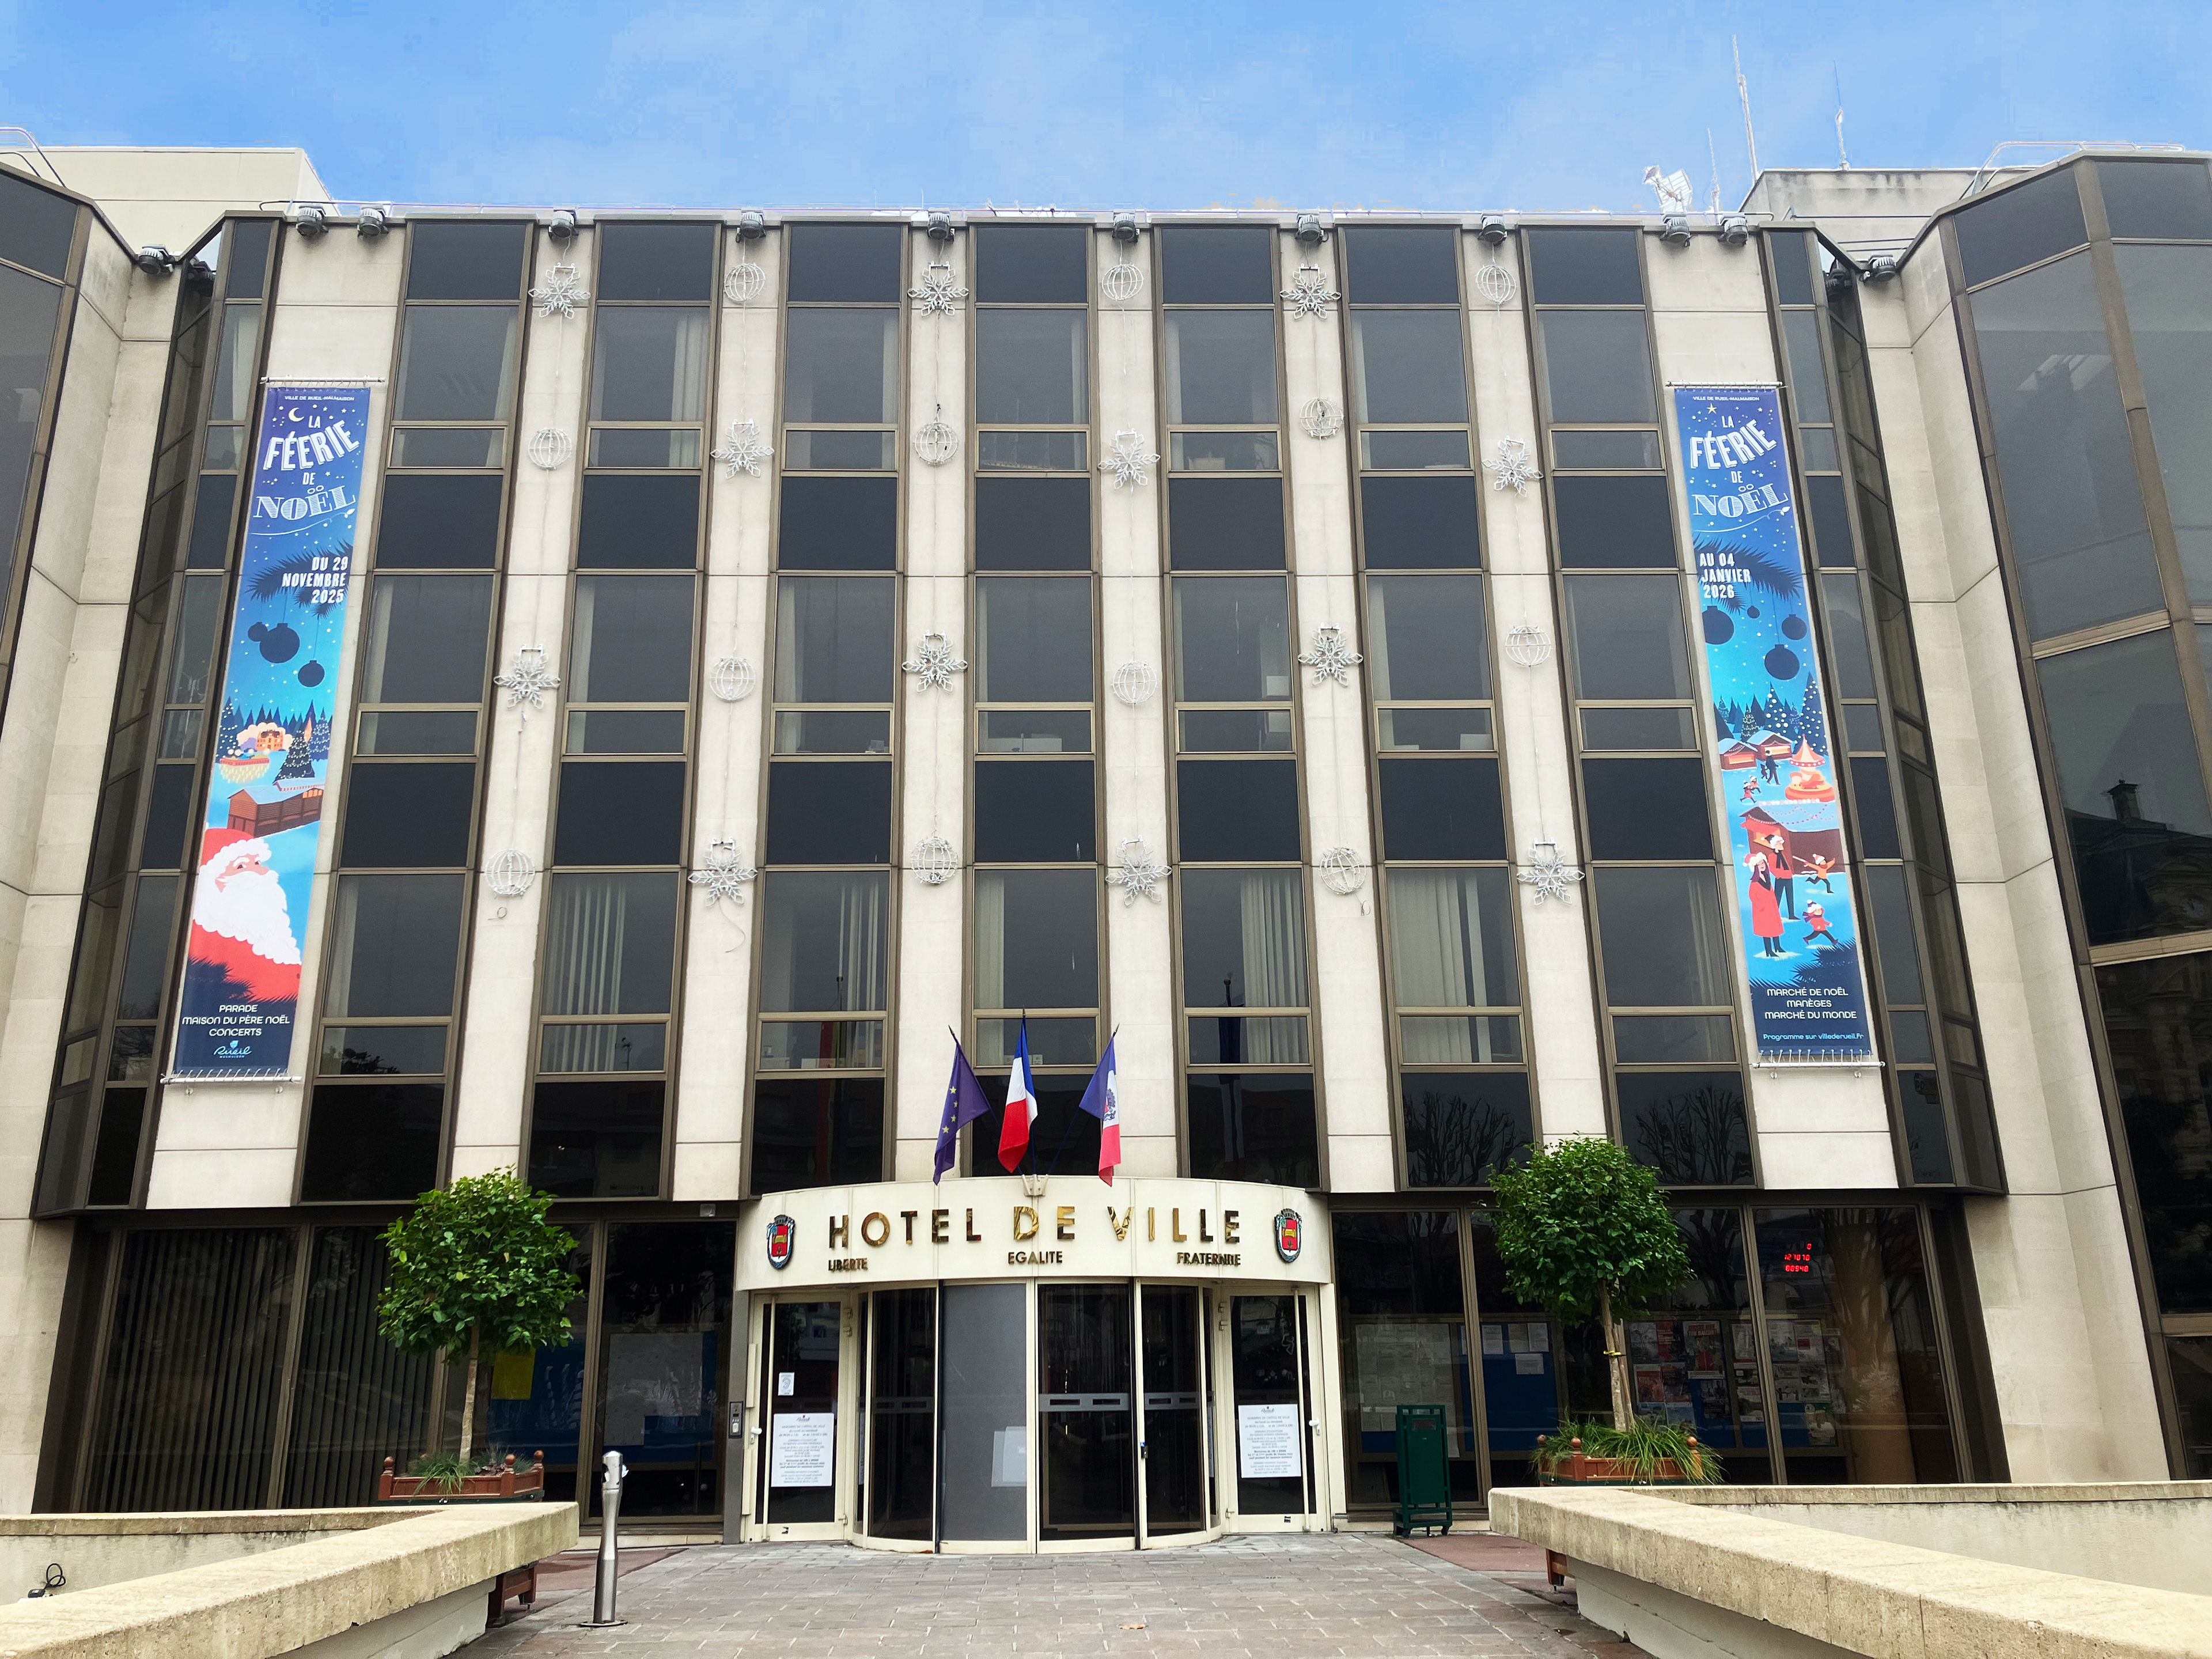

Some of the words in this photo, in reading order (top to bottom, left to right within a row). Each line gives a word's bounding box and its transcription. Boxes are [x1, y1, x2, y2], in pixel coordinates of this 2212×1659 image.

[308, 415, 320, 428] LA
[1721, 415, 1734, 427] LA
[263, 420, 360, 471] FÉERIE
[1690, 419, 1777, 469] FÉERIE
[302, 472, 316, 485] DE
[1730, 471, 1743, 483] DE
[253, 485, 356, 520] NOËL
[1692, 483, 1789, 517] NOËL
[311, 556, 328, 571] DU
[332, 556, 349, 571] 29
[1699, 553, 1714, 567] AU
[1719, 553, 1734, 567] 04
[282, 572, 347, 587] NOVEMBRE
[1701, 569, 1752, 583] JANVIER
[311, 589, 344, 604] 2025
[1703, 585, 1734, 599] 2026
[1767, 987, 1808, 996] MARCHÉ
[1824, 987, 1849, 996] NOËL
[219, 1005, 258, 1013] PARADE
[1787, 998, 1832, 1007] MANÈGES
[181, 1016, 221, 1025] MAISON
[223, 1016, 237, 1024] DU
[238, 1015, 263, 1024] PÈRE
[265, 1014, 290, 1024] NOËL
[1764, 1010, 1805, 1019] MARCHÉ
[209, 1028, 262, 1036] CONCERTS
[213, 1046, 252, 1055] Rueil
[829, 1208, 982, 1248] HOTEL
[1013, 1206, 1075, 1241] DE
[1107, 1206, 1240, 1243] VILLE
[828, 1257, 868, 1272] LIBERTE
[1008, 1251, 1063, 1264] EGALITE
[1177, 1252, 1241, 1266] FRATERNITE
